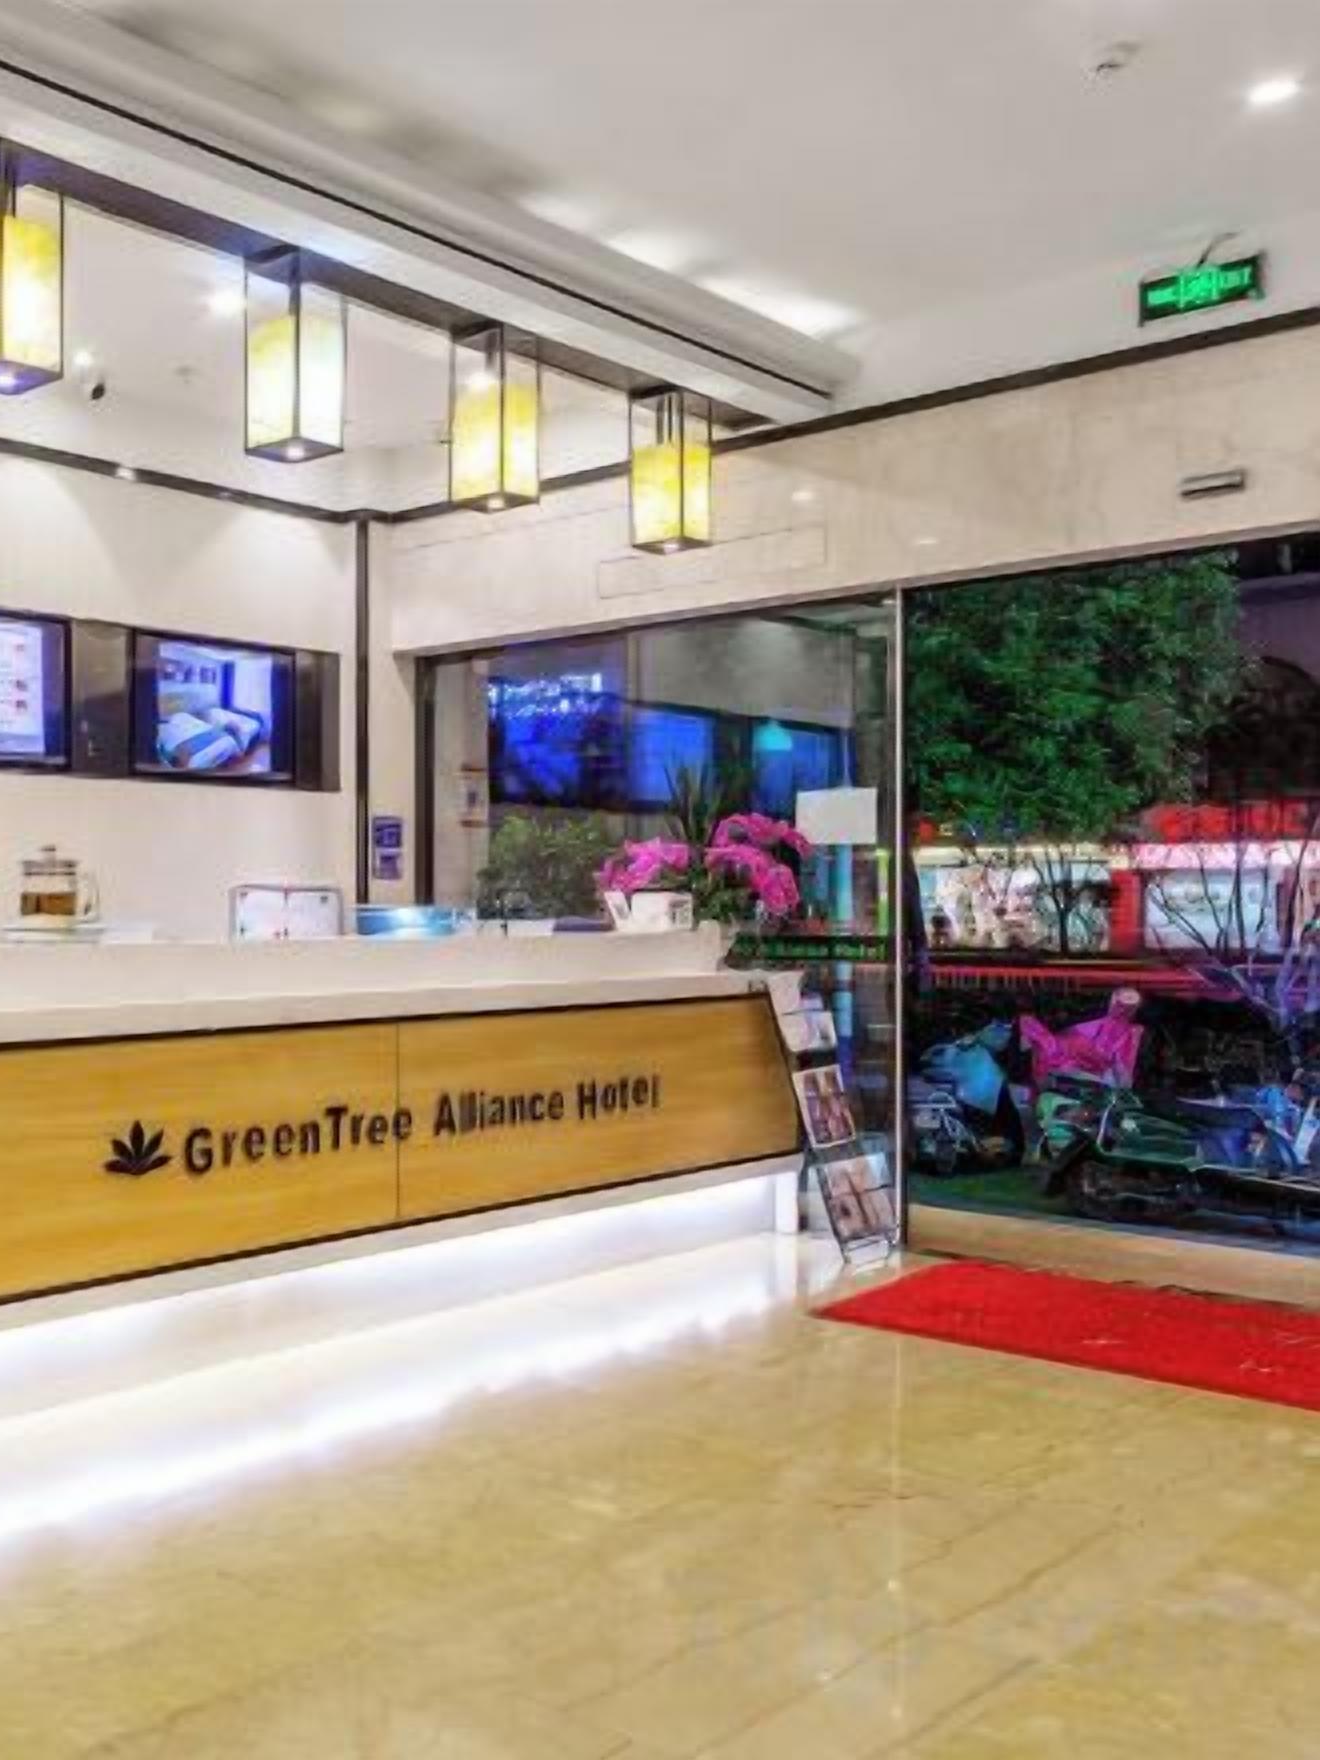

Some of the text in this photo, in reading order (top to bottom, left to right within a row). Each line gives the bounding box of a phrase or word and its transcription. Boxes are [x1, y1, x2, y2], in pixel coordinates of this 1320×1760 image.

[184, 1075, 659, 1175] GreenTree Alliance Hotel
